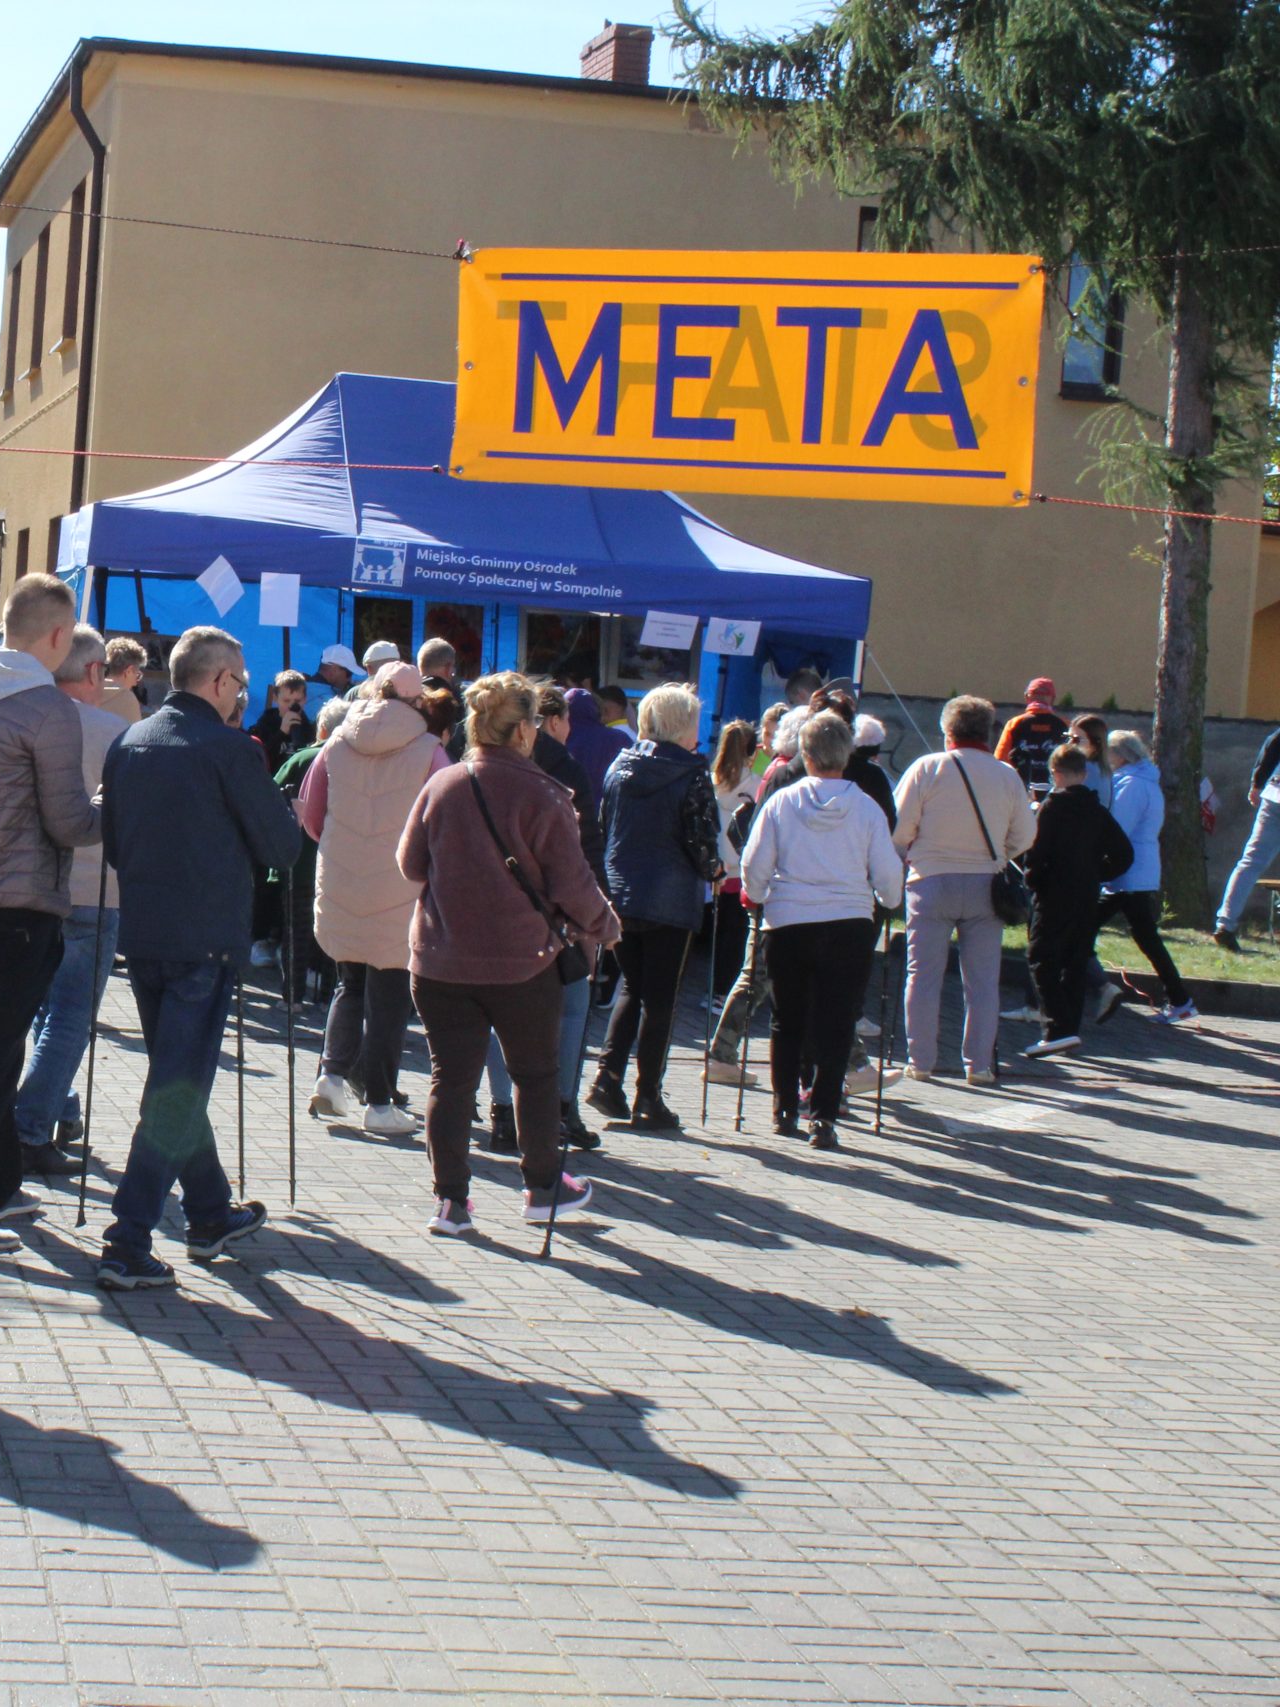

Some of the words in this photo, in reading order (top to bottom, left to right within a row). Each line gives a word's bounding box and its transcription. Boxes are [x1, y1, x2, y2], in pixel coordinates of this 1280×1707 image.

[512, 300, 980, 450] META
[416, 548, 522, 572] Miejsko-Gminny
[523, 560, 578, 576] Ośrodek
[414, 566, 466, 584] Pomocy
[468, 572, 538, 592] Społecznej
[540, 581, 552, 591] w
[554, 580, 623, 598] Sompolnie
